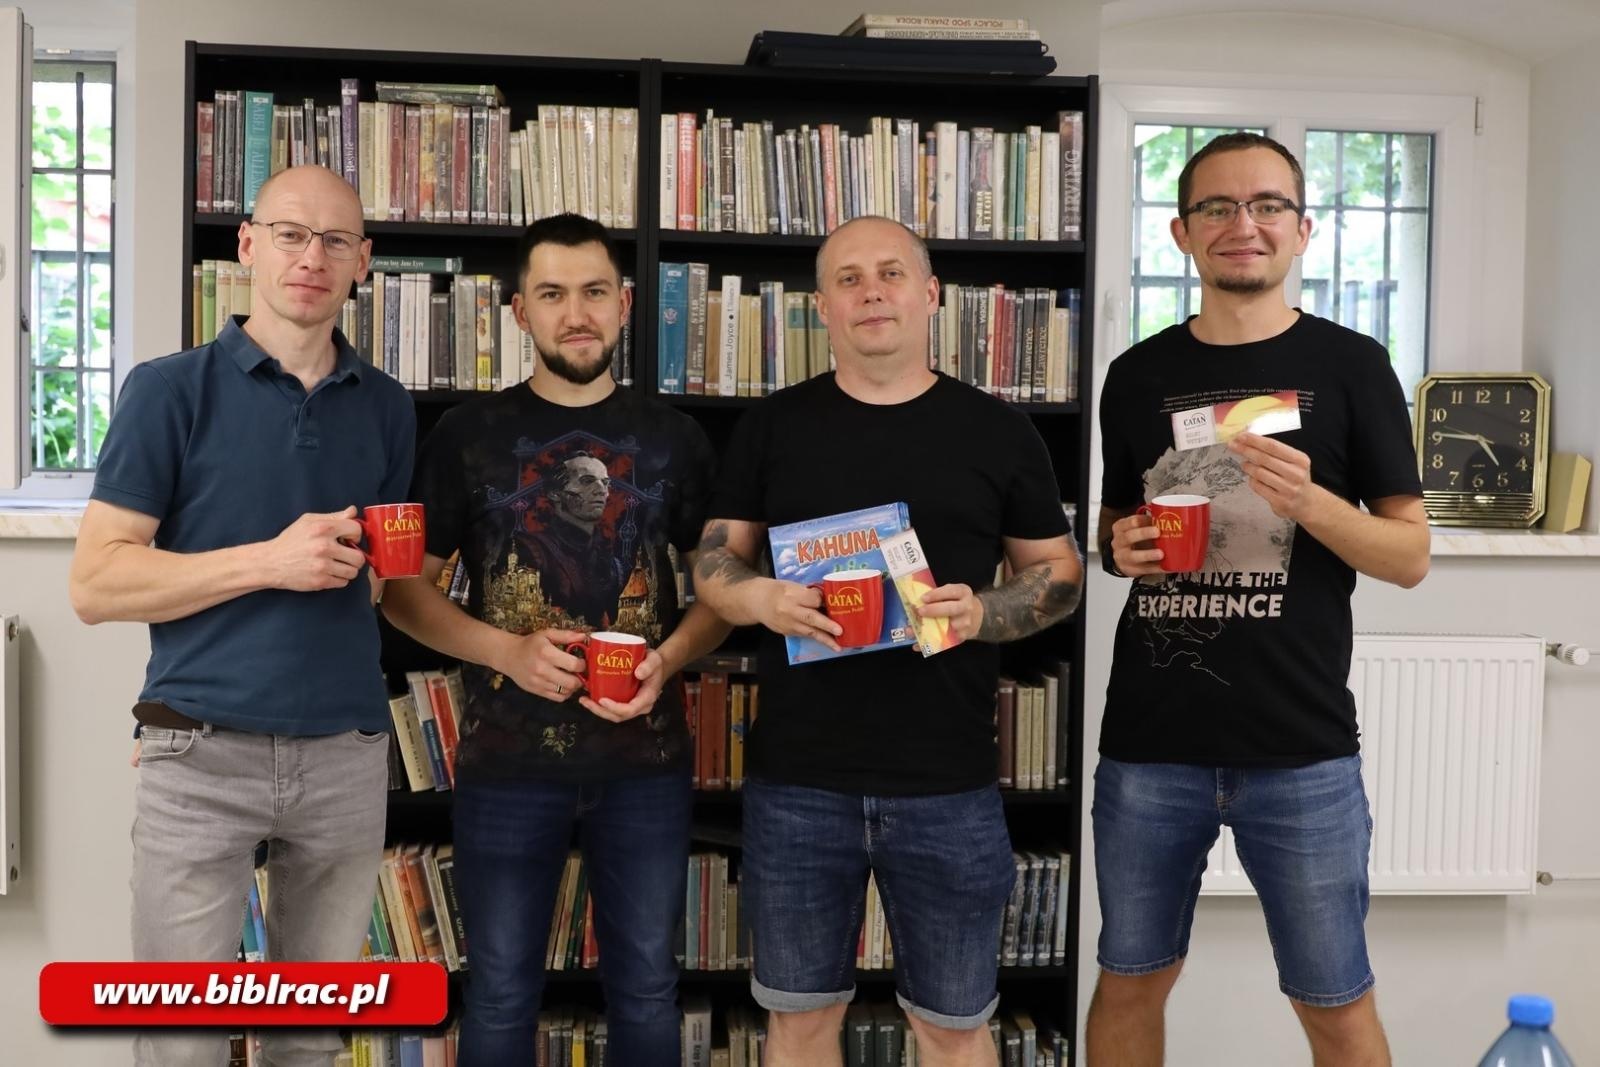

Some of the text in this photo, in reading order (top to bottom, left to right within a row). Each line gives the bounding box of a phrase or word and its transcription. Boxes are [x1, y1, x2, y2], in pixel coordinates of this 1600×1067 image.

[924, 18, 950, 27] ZNAKU
[952, 19, 971, 28] SPOD
[974, 20, 1003, 28] POLACY
[1064, 150, 1081, 212] IRVING
[724, 323, 735, 350] Joyce
[724, 352, 732, 380] James
[1451, 390, 1464, 404] 11
[1475, 389, 1492, 404] 12
[1504, 389, 1512, 404] 1
[1184, 416, 1206, 427] CATAN
[1431, 408, 1448, 422] 10
[1519, 409, 1531, 424] 2
[1431, 432, 1443, 446] 9
[1519, 433, 1530, 448] 3
[1432, 454, 1444, 469] 8
[1516, 456, 1528, 472] 4
[1448, 471, 1460, 486] 7
[1472, 474, 1484, 488] 6
[1497, 472, 1509, 487] 5
[384, 518, 422, 532] CATAN
[796, 527, 881, 564] KAHUNA
[904, 540, 917, 564] CATAN
[1200, 572, 1286, 588] LIVE THE
[828, 593, 864, 608] CATAN
[1138, 594, 1284, 618] EXPERIENCE
[596, 653, 633, 668] CATAN
